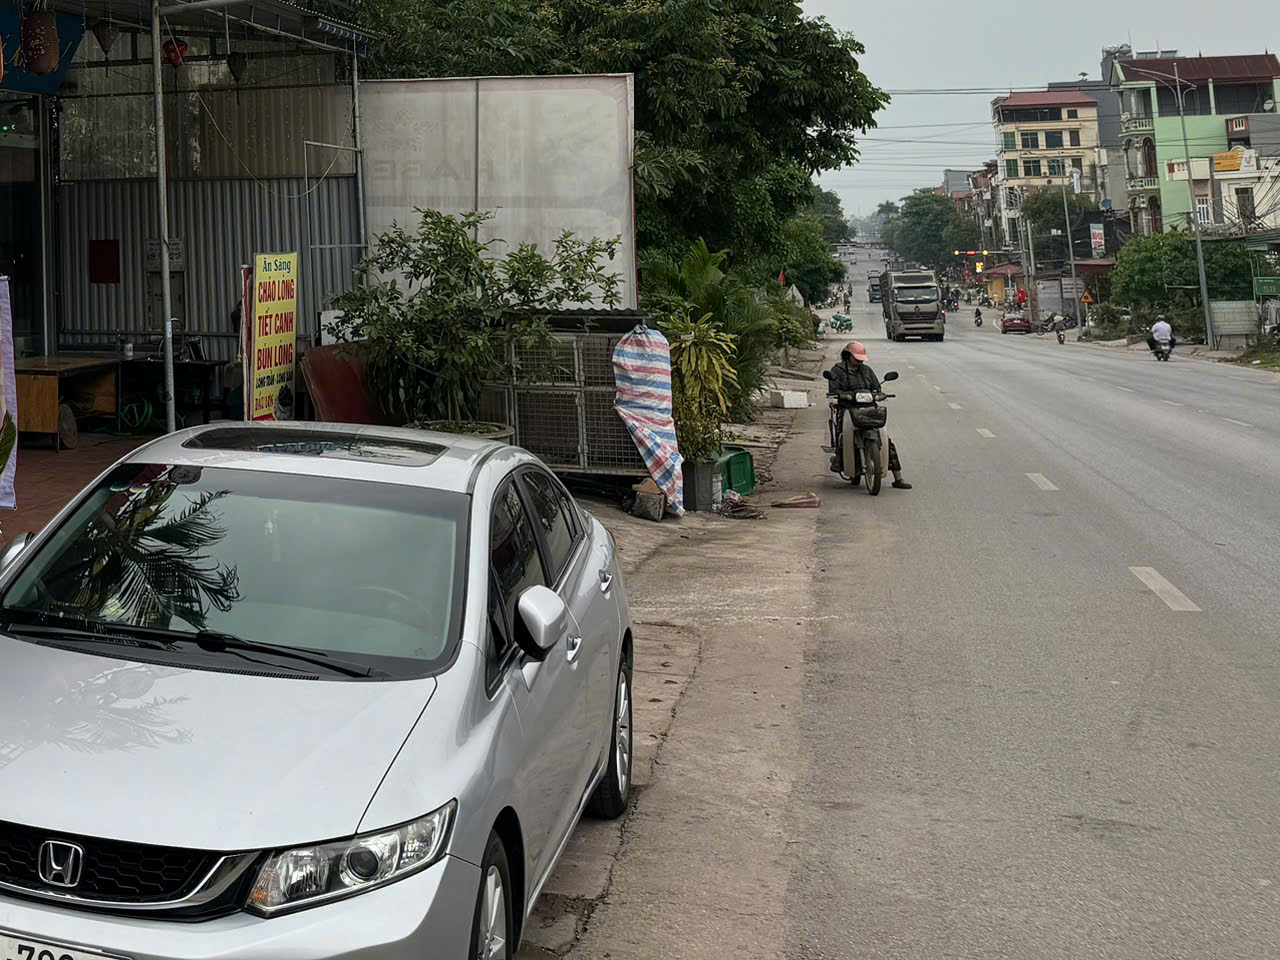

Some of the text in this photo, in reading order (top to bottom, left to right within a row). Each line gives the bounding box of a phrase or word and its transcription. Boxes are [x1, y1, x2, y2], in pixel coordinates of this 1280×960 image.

[262, 257, 292, 274] Ăn Sáng
[258, 274, 295, 304] CHÁO LÒNG
[258, 306, 294, 338] TIẾT CANH
[257, 340, 293, 371] BÚN LÒNG
